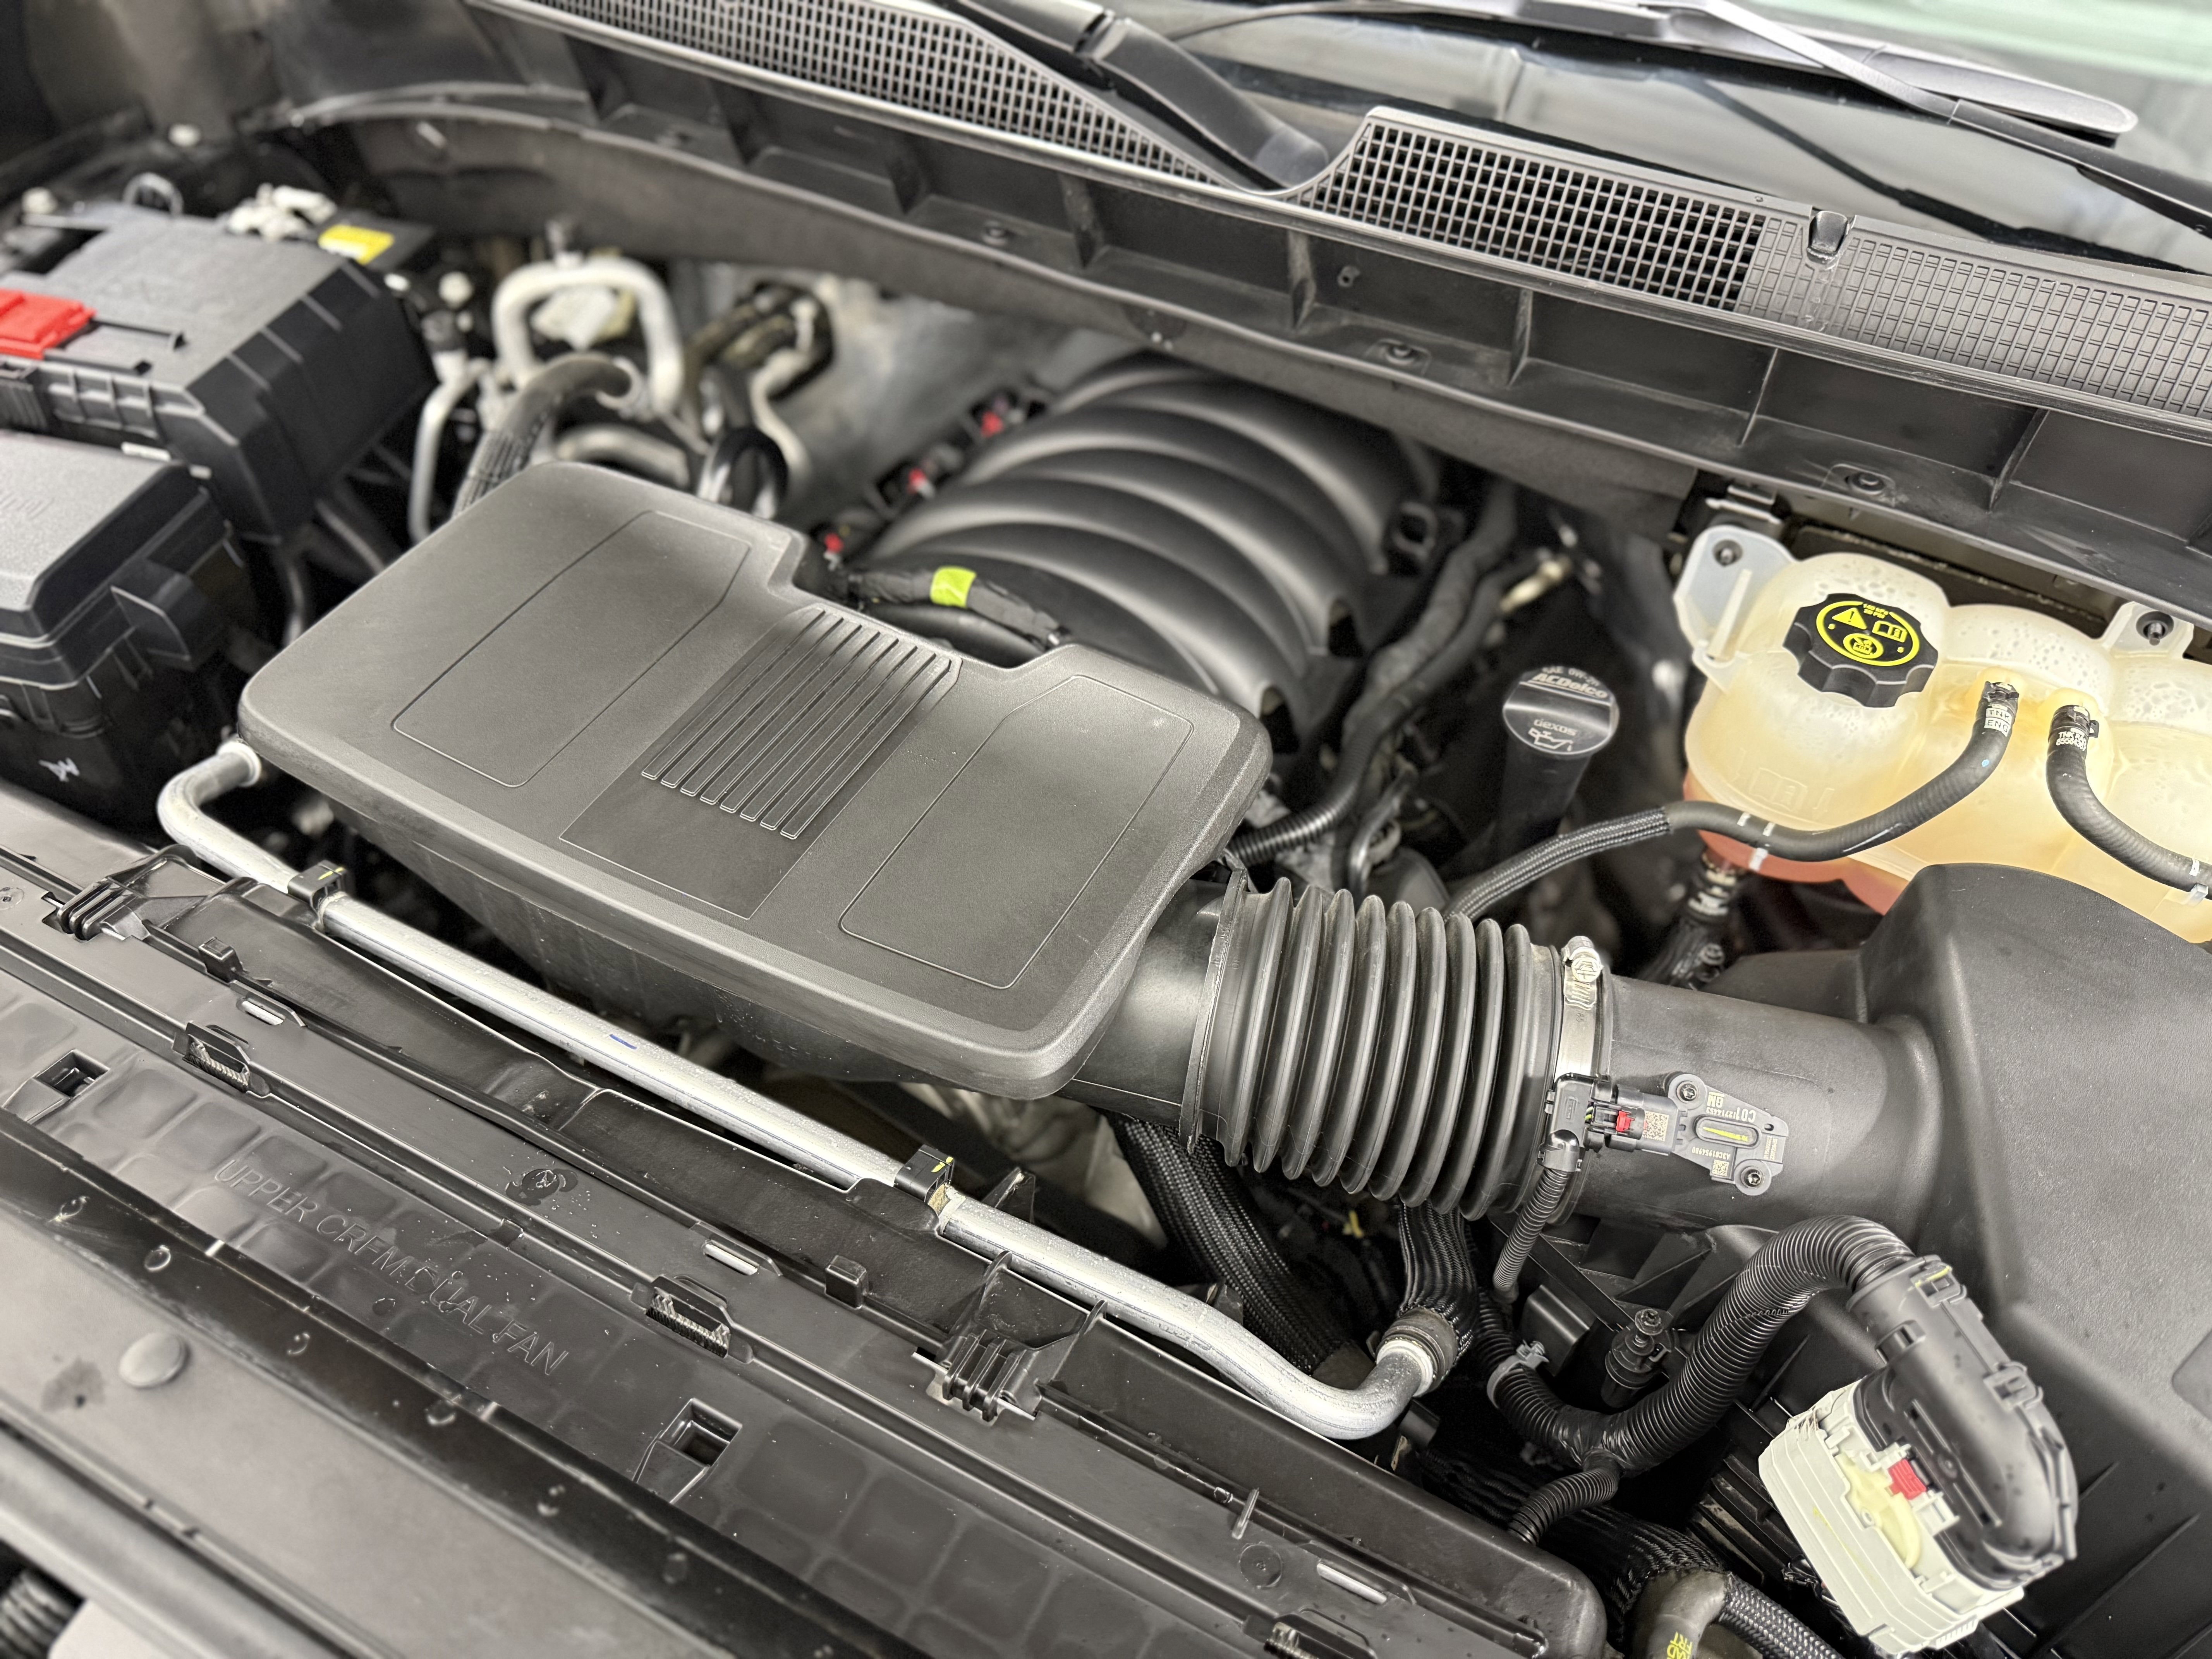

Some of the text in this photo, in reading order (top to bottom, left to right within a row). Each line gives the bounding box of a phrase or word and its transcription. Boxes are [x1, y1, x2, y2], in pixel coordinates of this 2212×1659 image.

[1532, 673, 1608, 698] ACDelco
[1989, 710, 2010, 722] TNK
[1987, 720, 2009, 733] ENG
[1707, 1093, 1724, 1108] GM
[1735, 1107, 1756, 1123] C01
[214, 1159, 569, 1376] UPPER CRFM DUAL FAN
[1670, 1631, 1693, 1655] FRT
